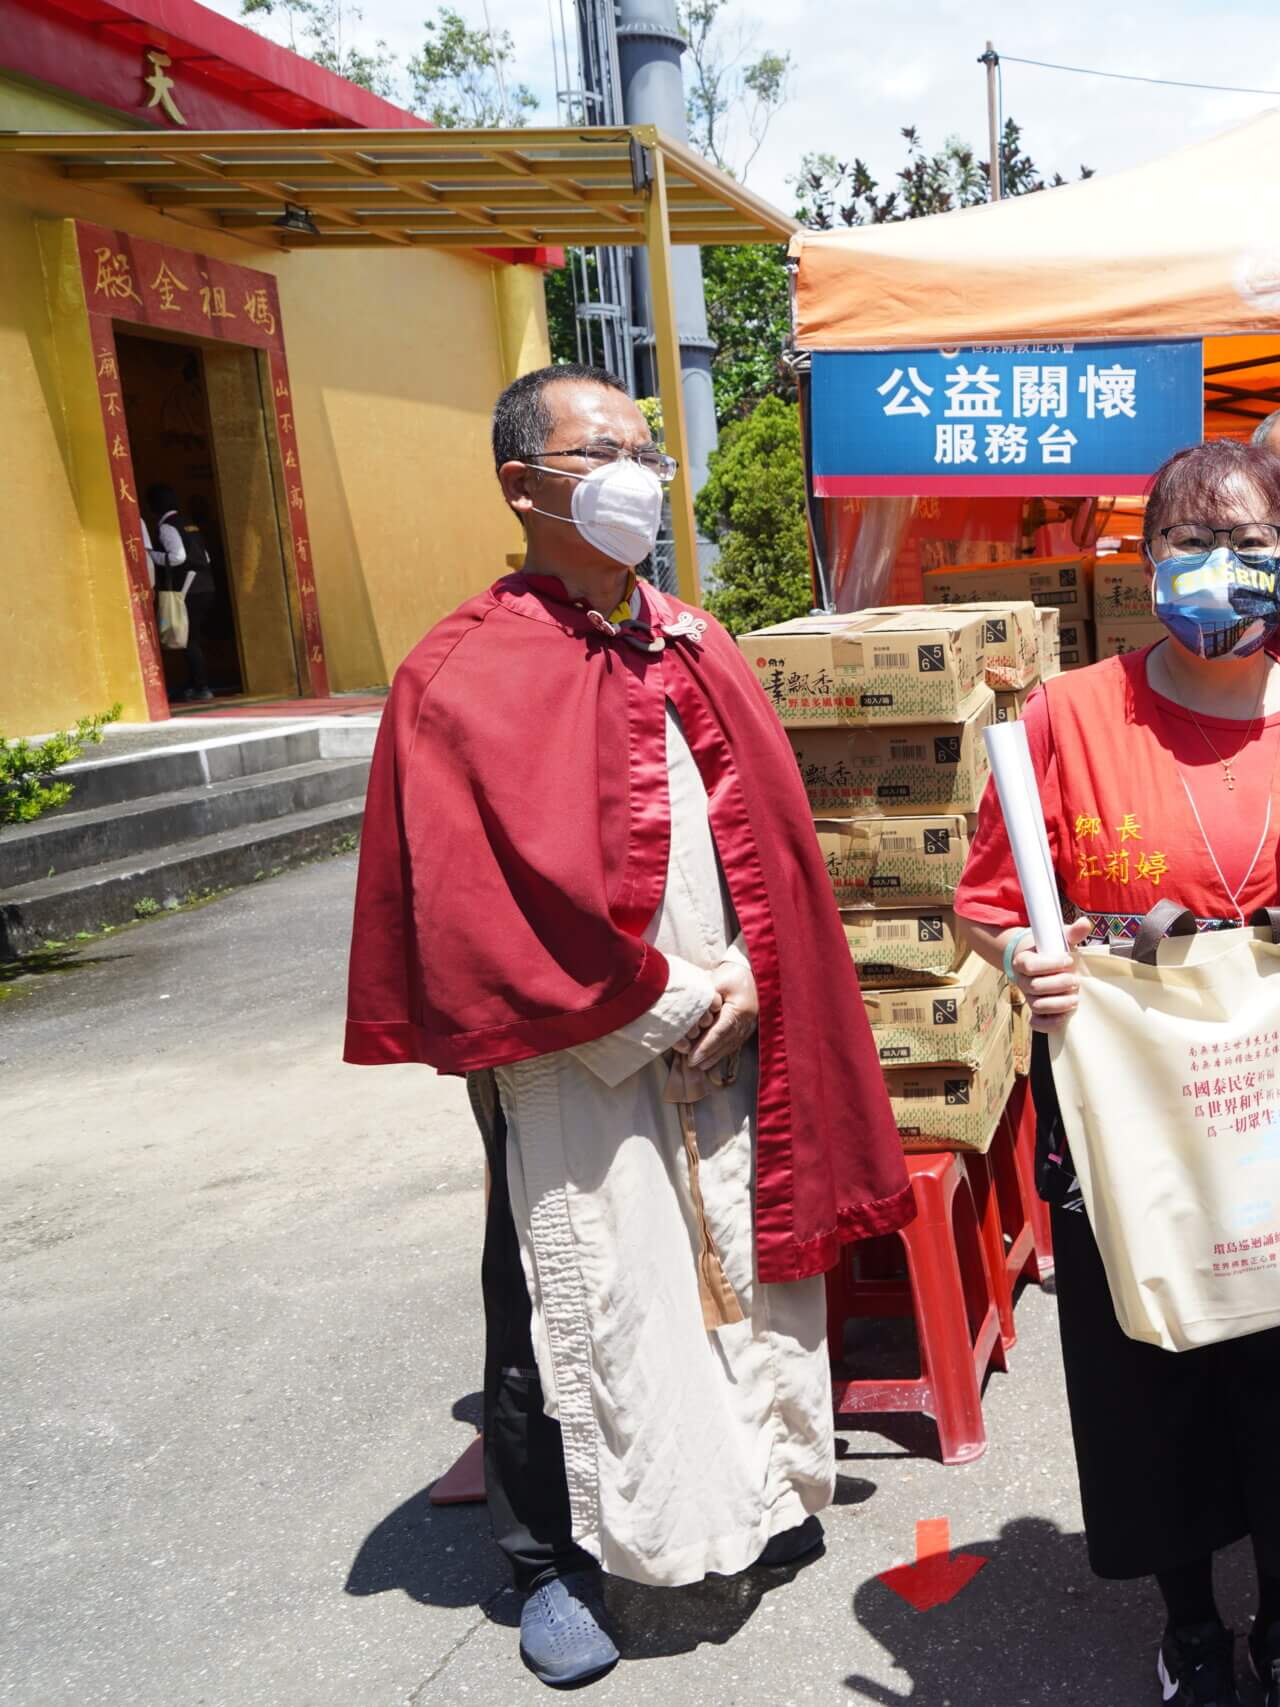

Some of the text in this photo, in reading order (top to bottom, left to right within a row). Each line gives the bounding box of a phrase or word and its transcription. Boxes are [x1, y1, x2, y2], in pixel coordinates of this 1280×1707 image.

[145, 50, 187, 126] 天
[877, 364, 1138, 419] 公益關懷
[934, 423, 1078, 465] 服務台
[987, 621, 1004, 642] 4 5
[921, 646, 942, 670] 5 6
[764, 668, 833, 704] 素飄香
[998, 708, 1006, 720] 5
[938, 739, 958, 762] 5 6
[927, 830, 947, 853] 5 6
[1078, 849, 1169, 886] 江莉婷
[920, 920, 941, 940] 5 6
[935, 1001, 954, 1023] 5 6
[947, 1094, 955, 1104] 6
